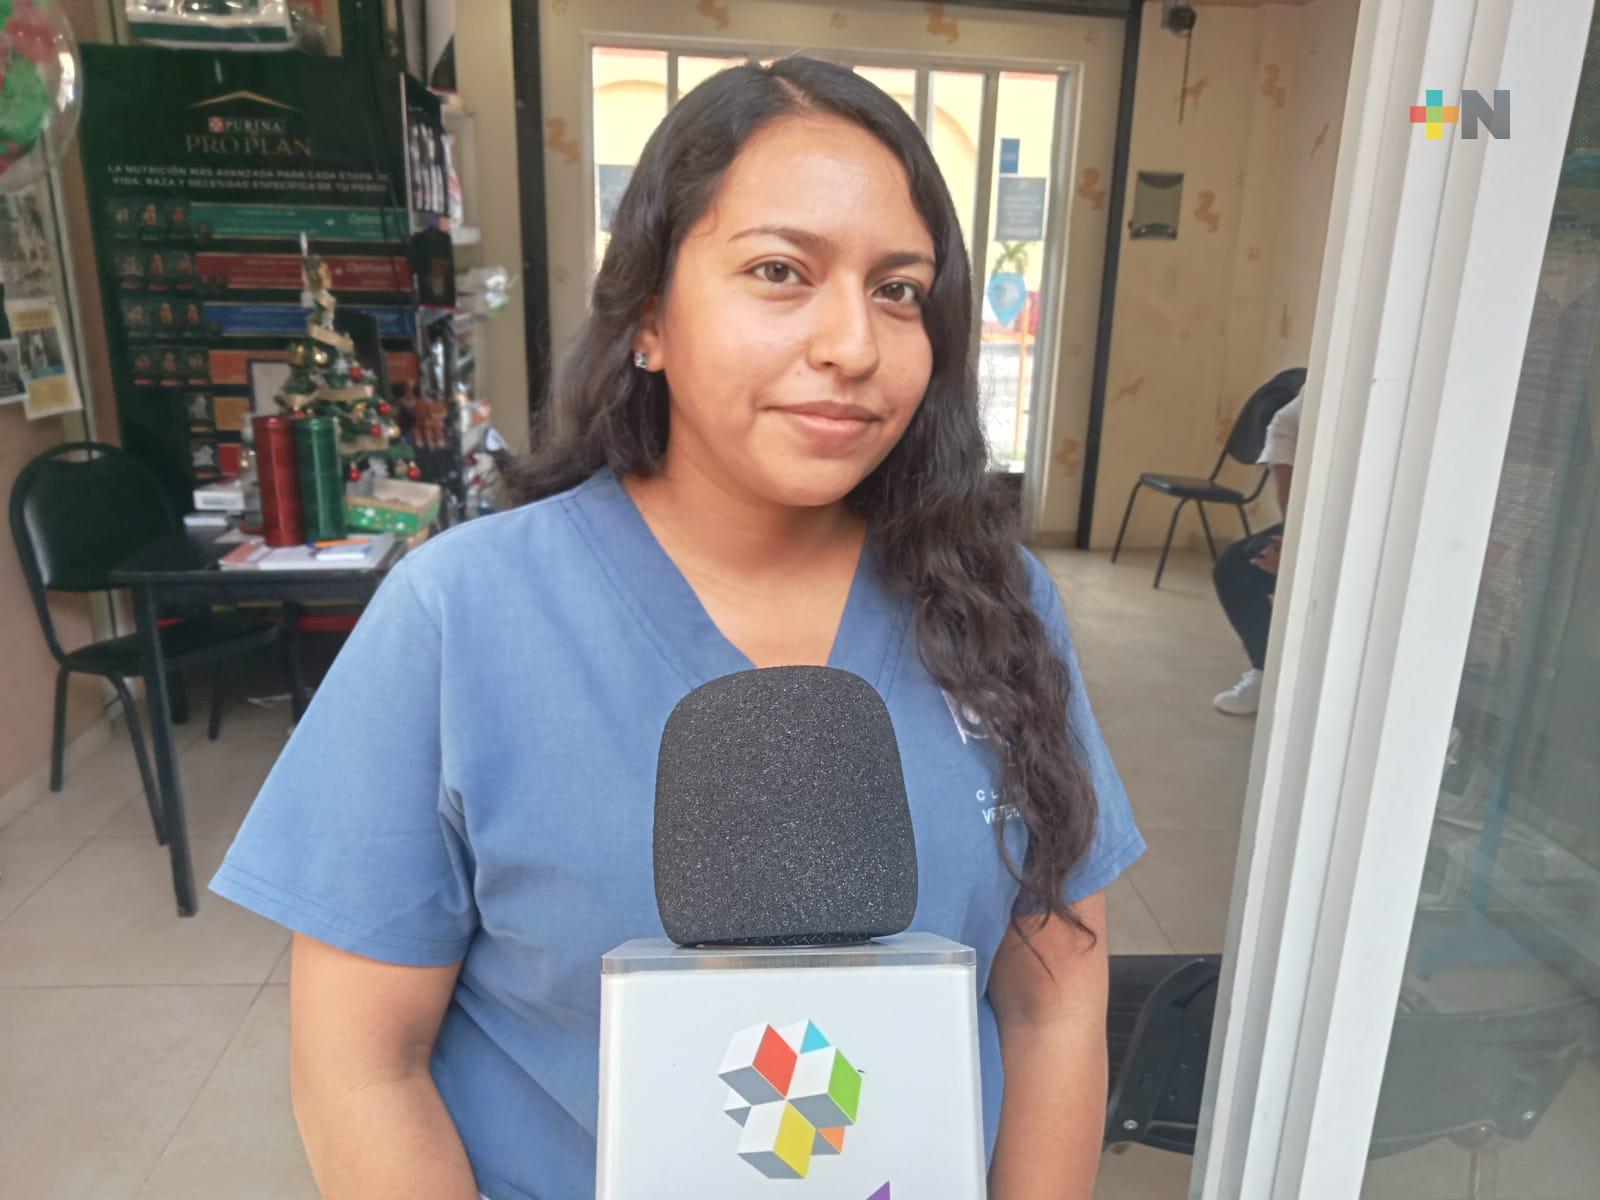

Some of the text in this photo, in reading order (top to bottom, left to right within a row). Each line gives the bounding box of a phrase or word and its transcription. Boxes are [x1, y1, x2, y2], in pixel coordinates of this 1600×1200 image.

[225, 120, 281, 132] PURINA
[185, 134, 312, 155] PRO PLAN
[107, 165, 121, 173] LA
